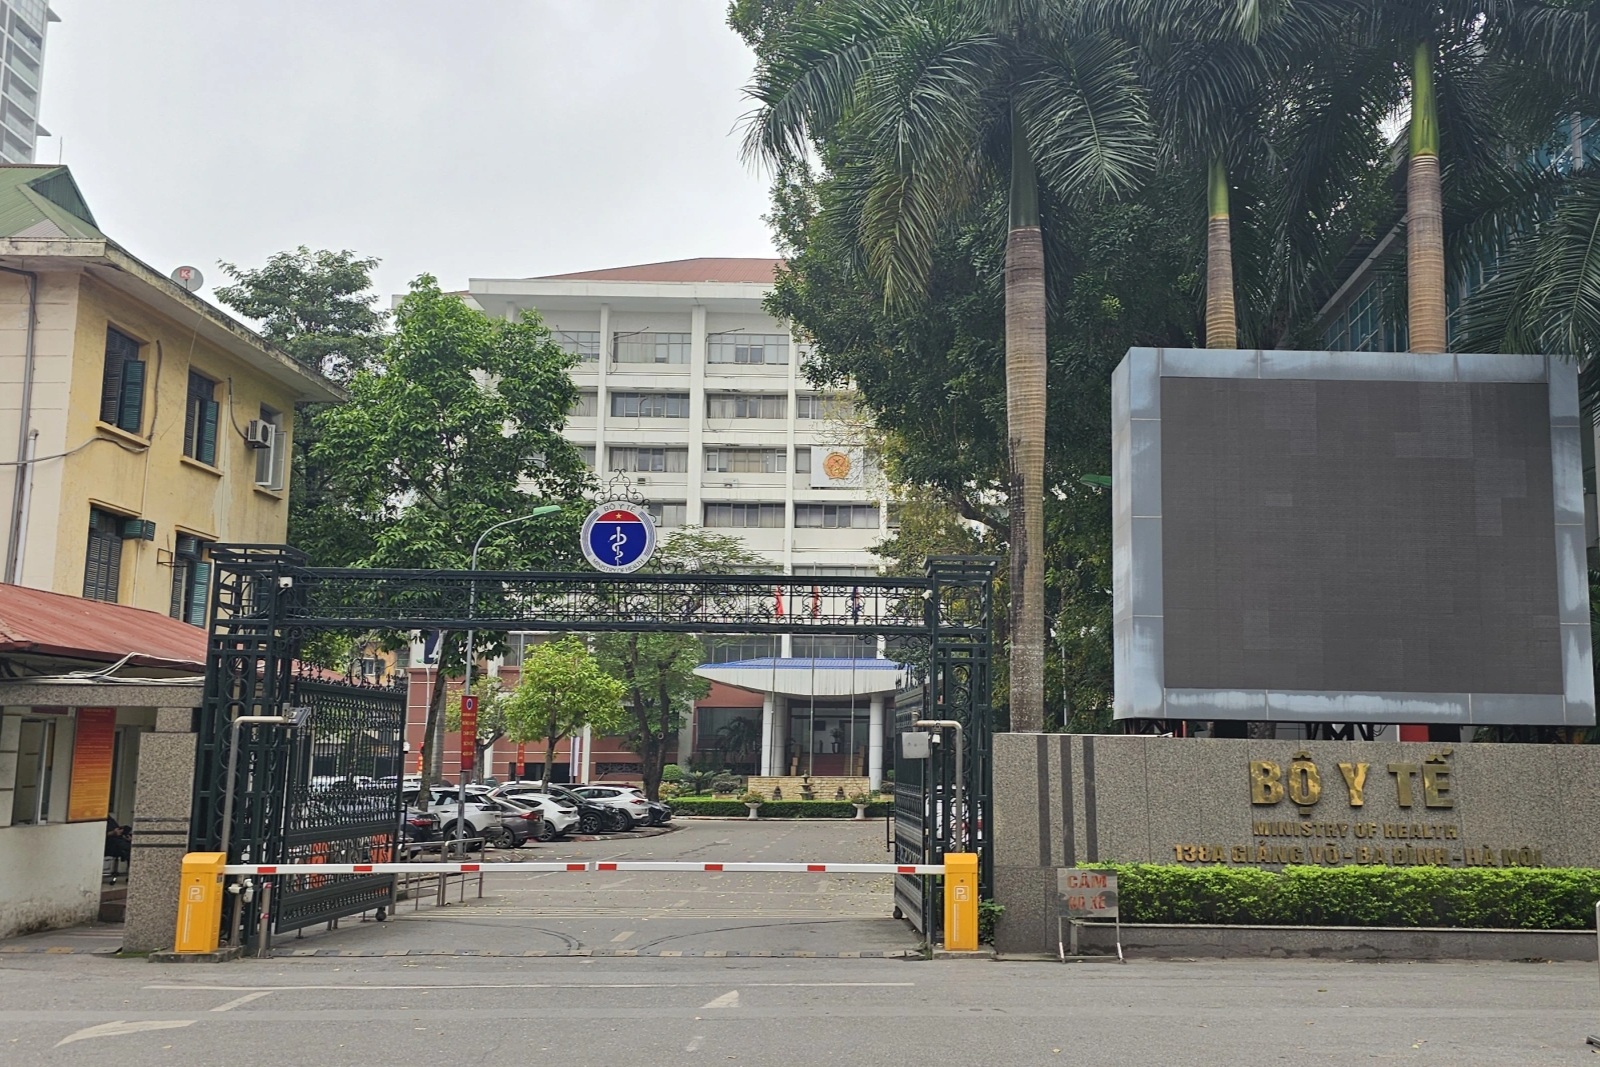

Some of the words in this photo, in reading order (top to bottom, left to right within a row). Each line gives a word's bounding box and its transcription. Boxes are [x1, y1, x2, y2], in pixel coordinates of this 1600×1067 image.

[592, 558, 616, 572] MINISTRY
[625, 558, 645, 571] HEALTH
[1250, 751, 1321, 815] BỘ
[1337, 762, 1370, 806] Y
[1387, 747, 1454, 808] TẾ
[1253, 821, 1348, 838] MINISTRY
[1354, 822, 1377, 839] OF
[1383, 823, 1458, 840] HEALTH
[1174, 843, 1227, 863] 138A
[1231, 840, 1304, 864] GIẢNG
[1308, 843, 1339, 864] VÕ
[1356, 846, 1388, 865] BA
[1392, 842, 1449, 866] ĐÌNH
[1464, 844, 1497, 866] HÀ
